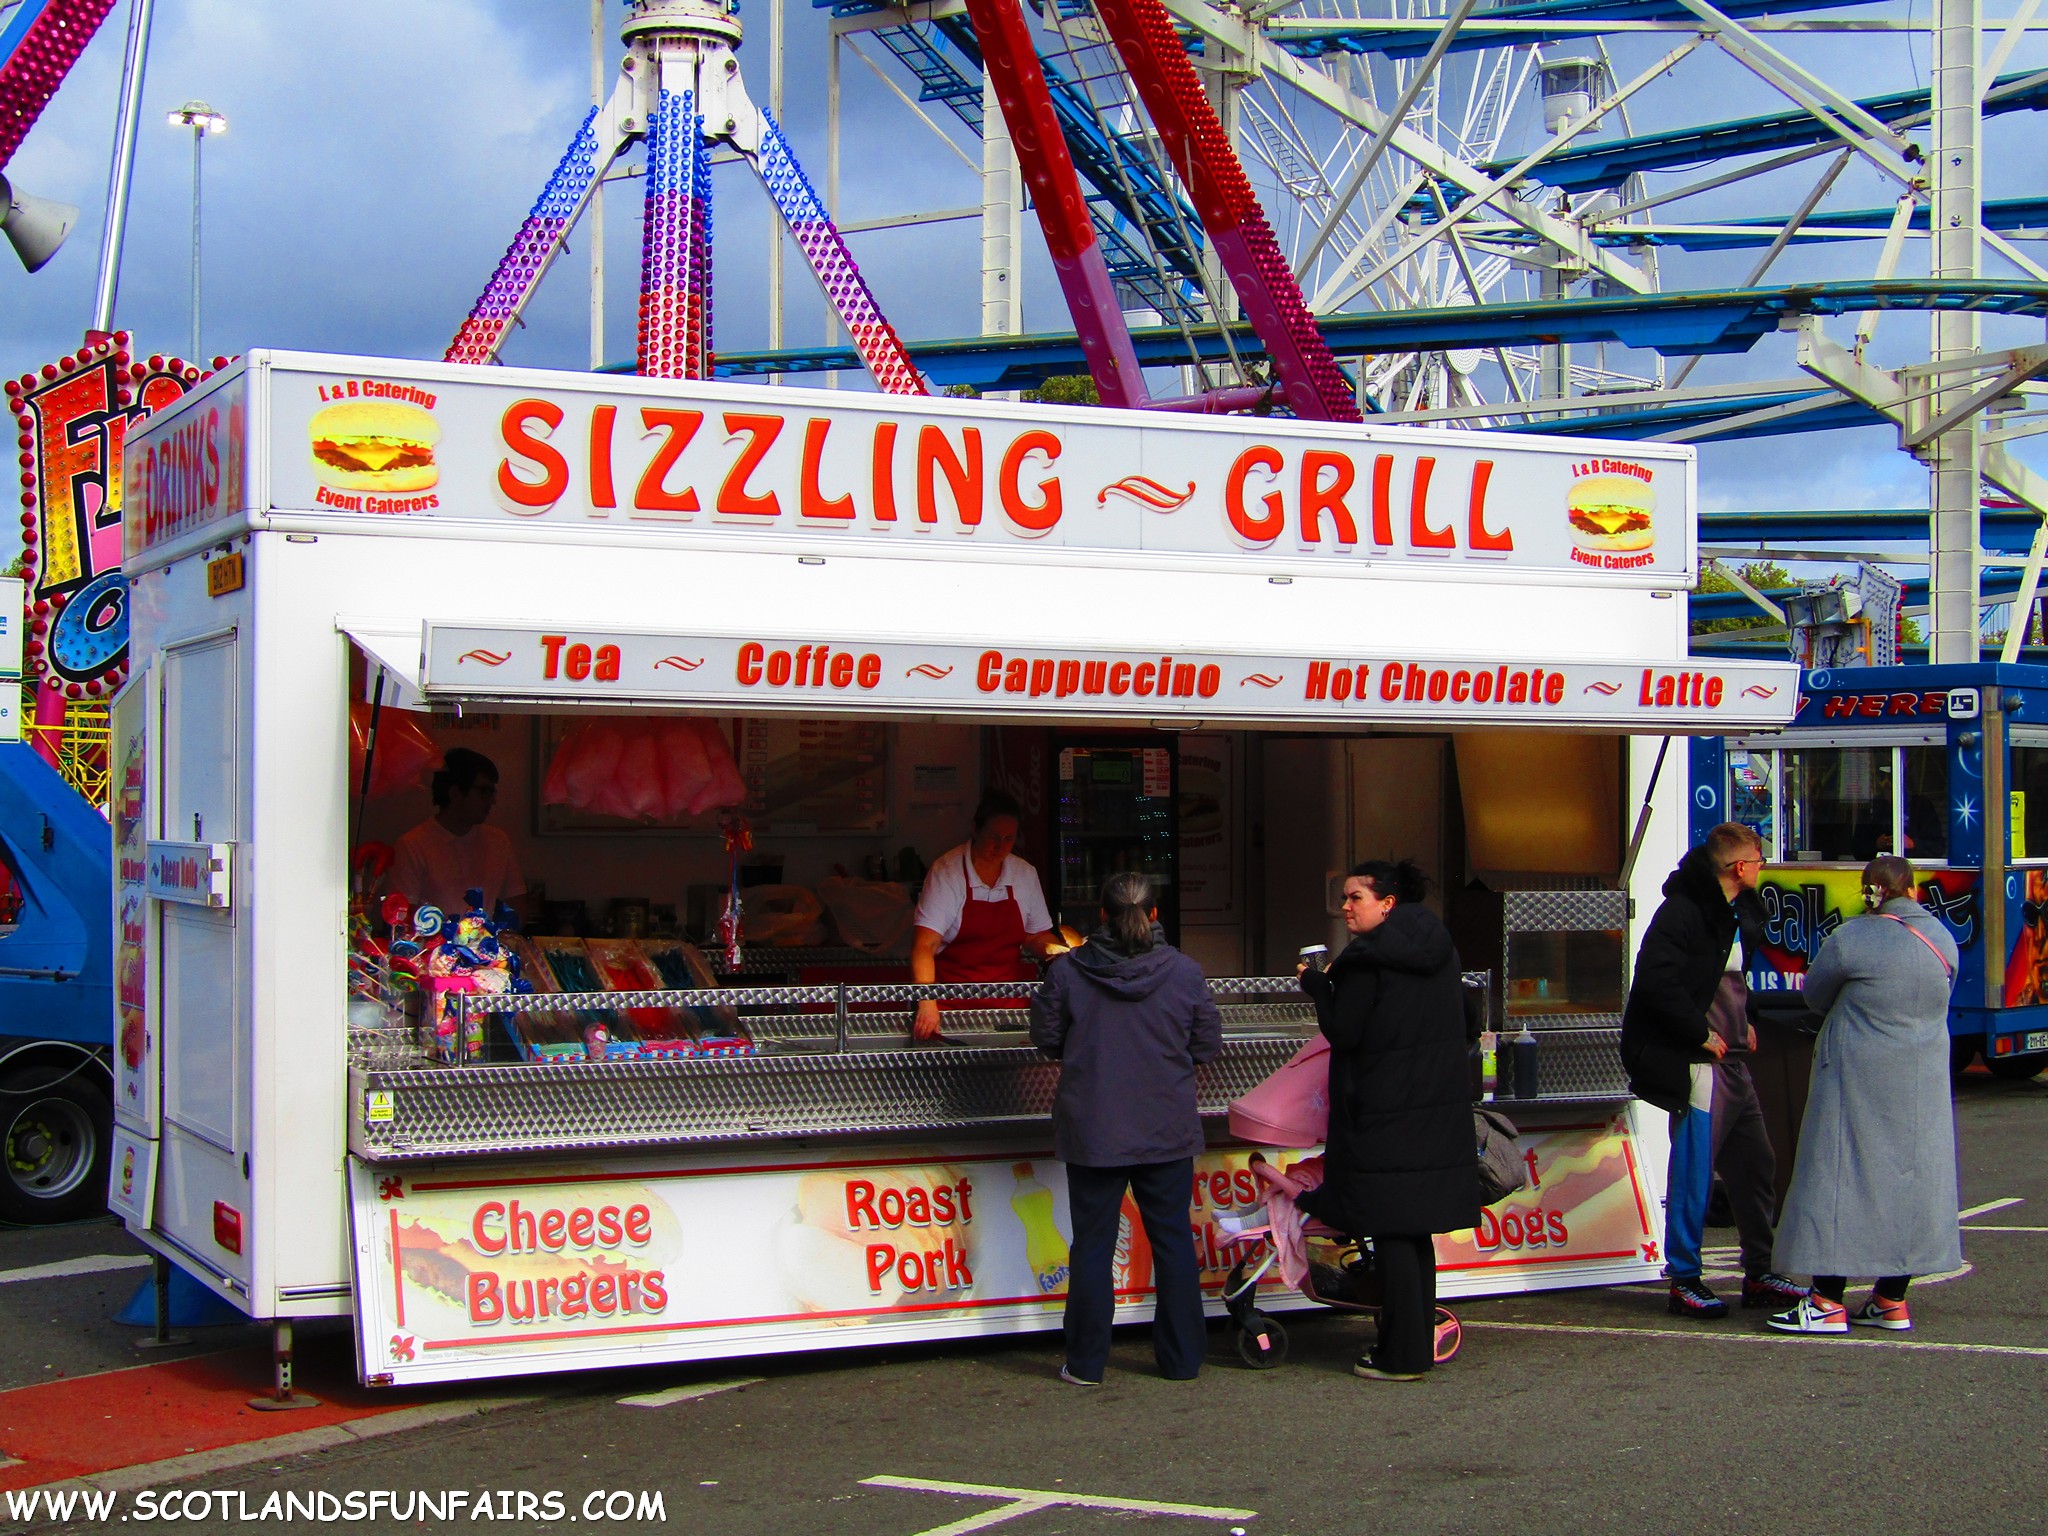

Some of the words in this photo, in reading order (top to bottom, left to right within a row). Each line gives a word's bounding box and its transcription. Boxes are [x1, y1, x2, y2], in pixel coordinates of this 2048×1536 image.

[318, 385, 329, 402] L
[331, 385, 344, 400] &
[346, 380, 359, 398] B
[362, 379, 437, 410] Catering
[145, 407, 220, 545] DRINKS
[497, 398, 1062, 533] SIZZLING
[1225, 445, 1514, 552] GRILL
[1571, 463, 1580, 478] L
[1581, 463, 1590, 476] &
[1591, 459, 1600, 474] B
[1602, 458, 1653, 482] Catering
[315, 486, 363, 512] Event
[365, 494, 440, 514] Caterers
[1570, 547, 1602, 568] Event
[1604, 552, 1655, 570] Caterers
[541, 635, 622, 682] Tea
[736, 641, 882, 689] Coffee
[977, 650, 1221, 698] Cappuccino
[1305, 661, 1367, 702] Hot
[1380, 662, 1565, 705] Chocolate
[1639, 669, 1723, 707] Latte
[1823, 691, 1950, 719] HERE
[471, 1200, 652, 1256] Cheese
[844, 1176, 973, 1231] Roast
[1473, 1206, 1568, 1252] Dogs
[864, 1237, 973, 1295] Pork
[466, 1270, 668, 1327] Burgers
